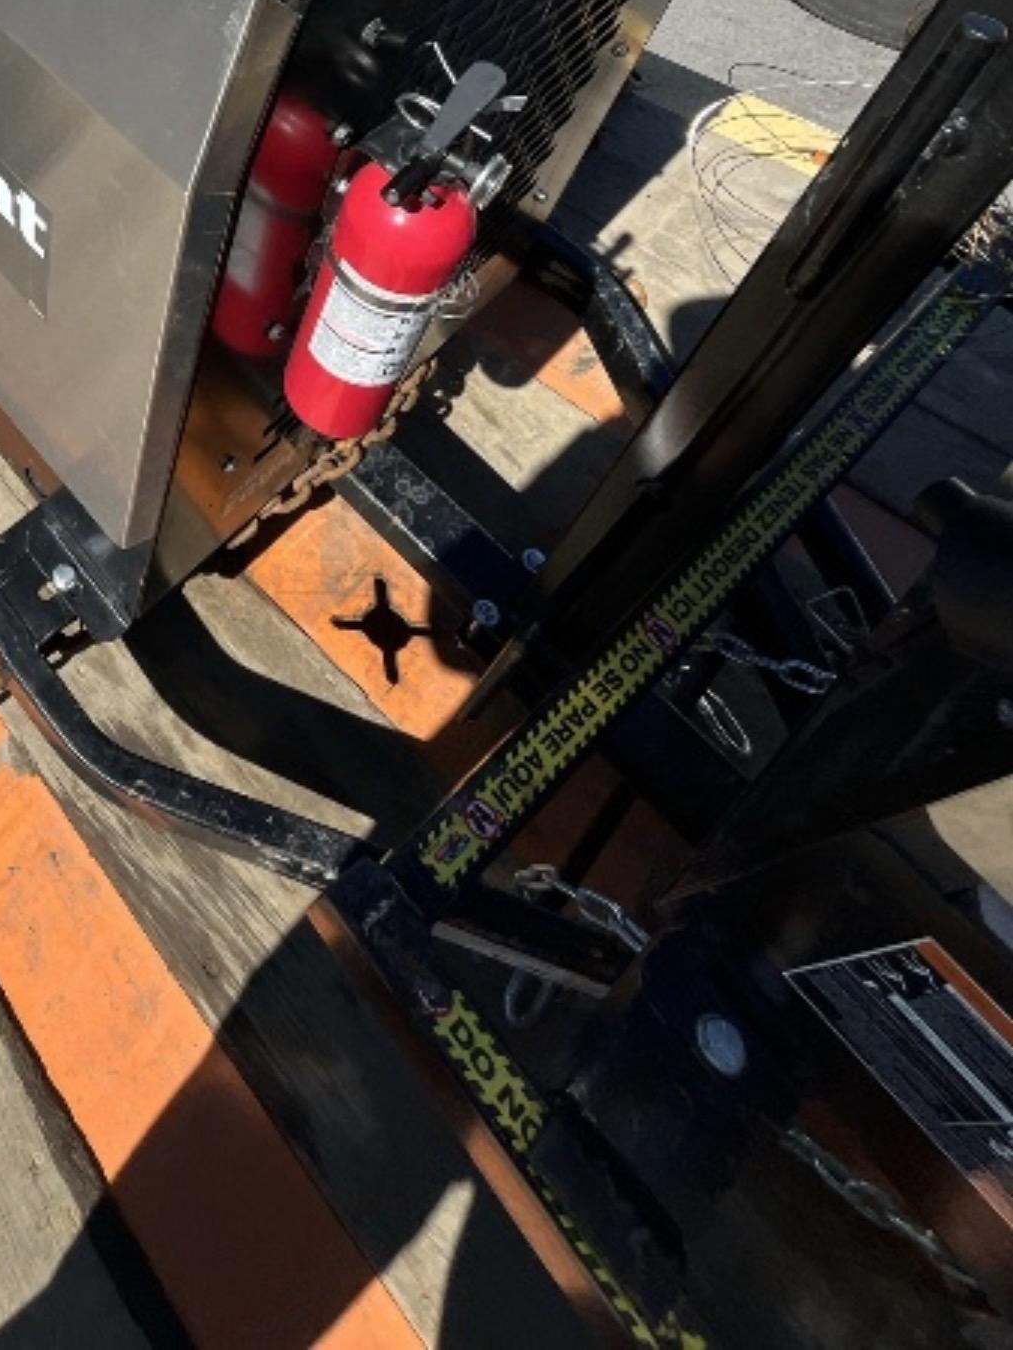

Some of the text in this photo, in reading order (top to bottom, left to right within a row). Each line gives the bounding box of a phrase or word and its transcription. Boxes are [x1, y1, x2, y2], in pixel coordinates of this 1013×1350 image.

[691, 524, 761, 597] DEBOUT
[591, 668, 625, 699] SE
[619, 642, 654, 673] NO
[540, 694, 599, 756] PARE
[448, 1016, 540, 1146] DO NO
